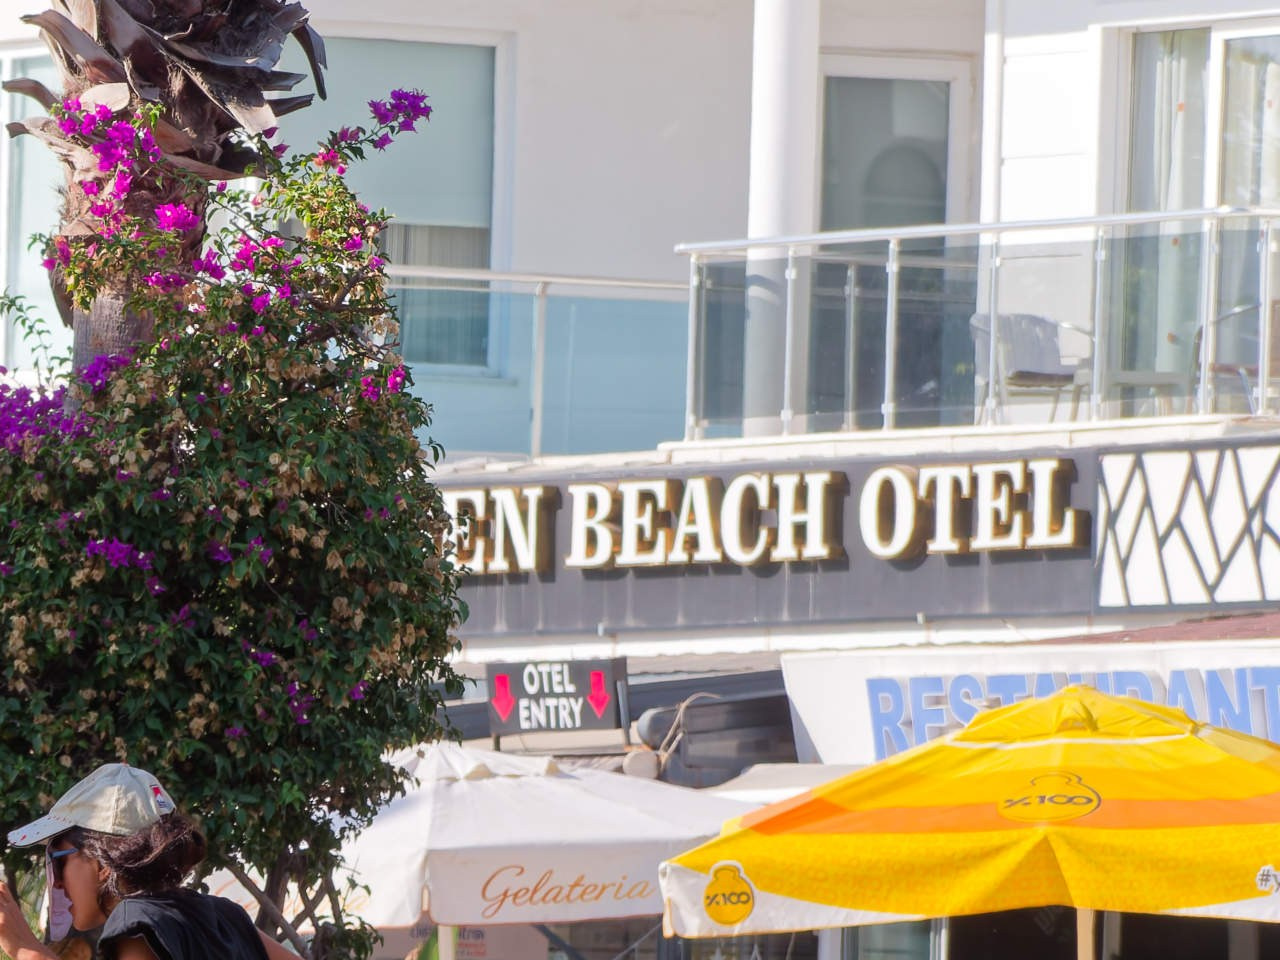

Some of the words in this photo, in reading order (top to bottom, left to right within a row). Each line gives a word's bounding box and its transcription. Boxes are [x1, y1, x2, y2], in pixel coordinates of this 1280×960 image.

[565, 472, 832, 568] BEACH
[859, 459, 1076, 559] OTEL
[523, 663, 576, 695] OTEL
[519, 696, 584, 730] ENTRY
[480, 864, 655, 919] Gelateria
